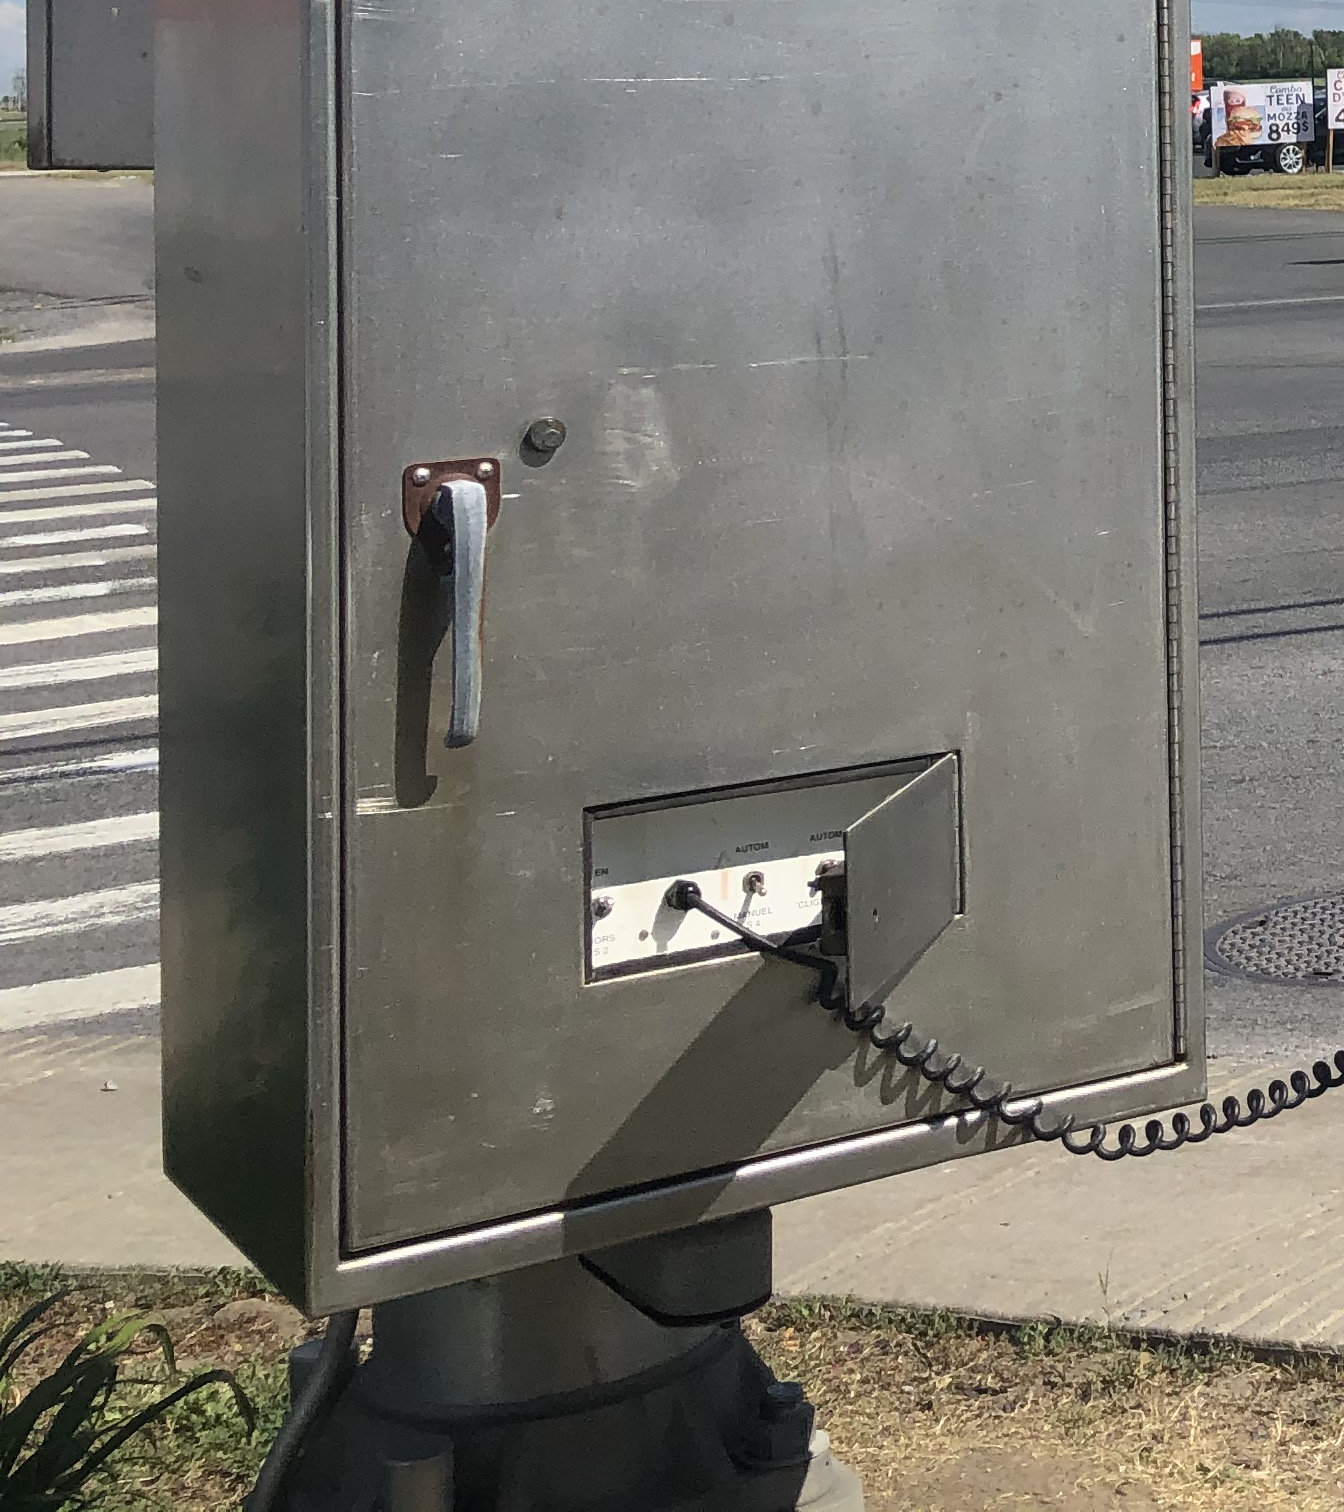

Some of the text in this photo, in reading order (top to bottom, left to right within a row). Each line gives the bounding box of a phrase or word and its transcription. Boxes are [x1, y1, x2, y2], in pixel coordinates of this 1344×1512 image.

[1269, 85, 1303, 94] Combo
[1266, 93, 1306, 106] TEEN
[1267, 110, 1308, 122] MOZZA
[735, 841, 770, 854] AUTOM
